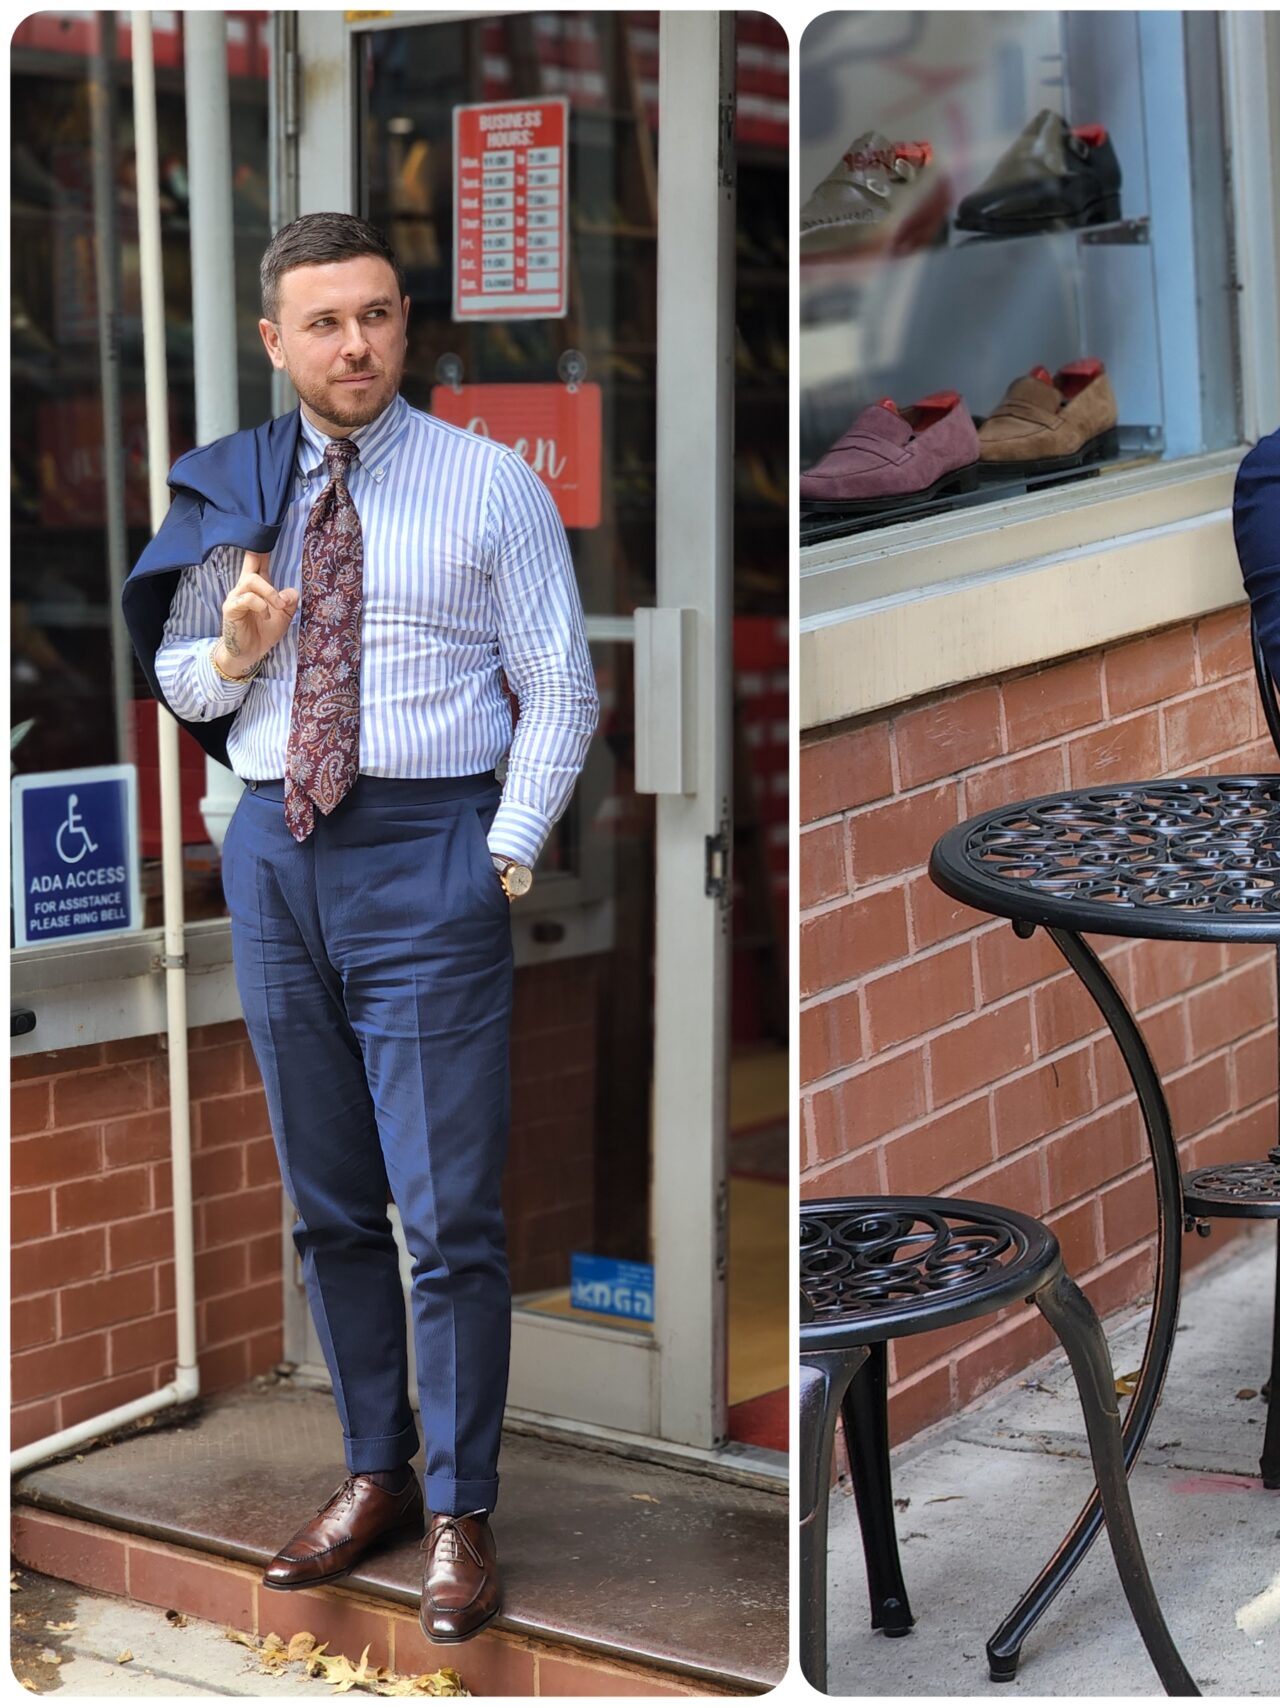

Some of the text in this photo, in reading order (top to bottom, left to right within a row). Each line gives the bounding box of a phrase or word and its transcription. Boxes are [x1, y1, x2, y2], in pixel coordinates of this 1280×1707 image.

[479, 111, 542, 130] BUSINESS
[30, 866, 126, 894] ADA ACCESS
[35, 892, 121, 914] FOR ASSISTANCE
[30, 908, 126, 931] PLEASE RING BELL
